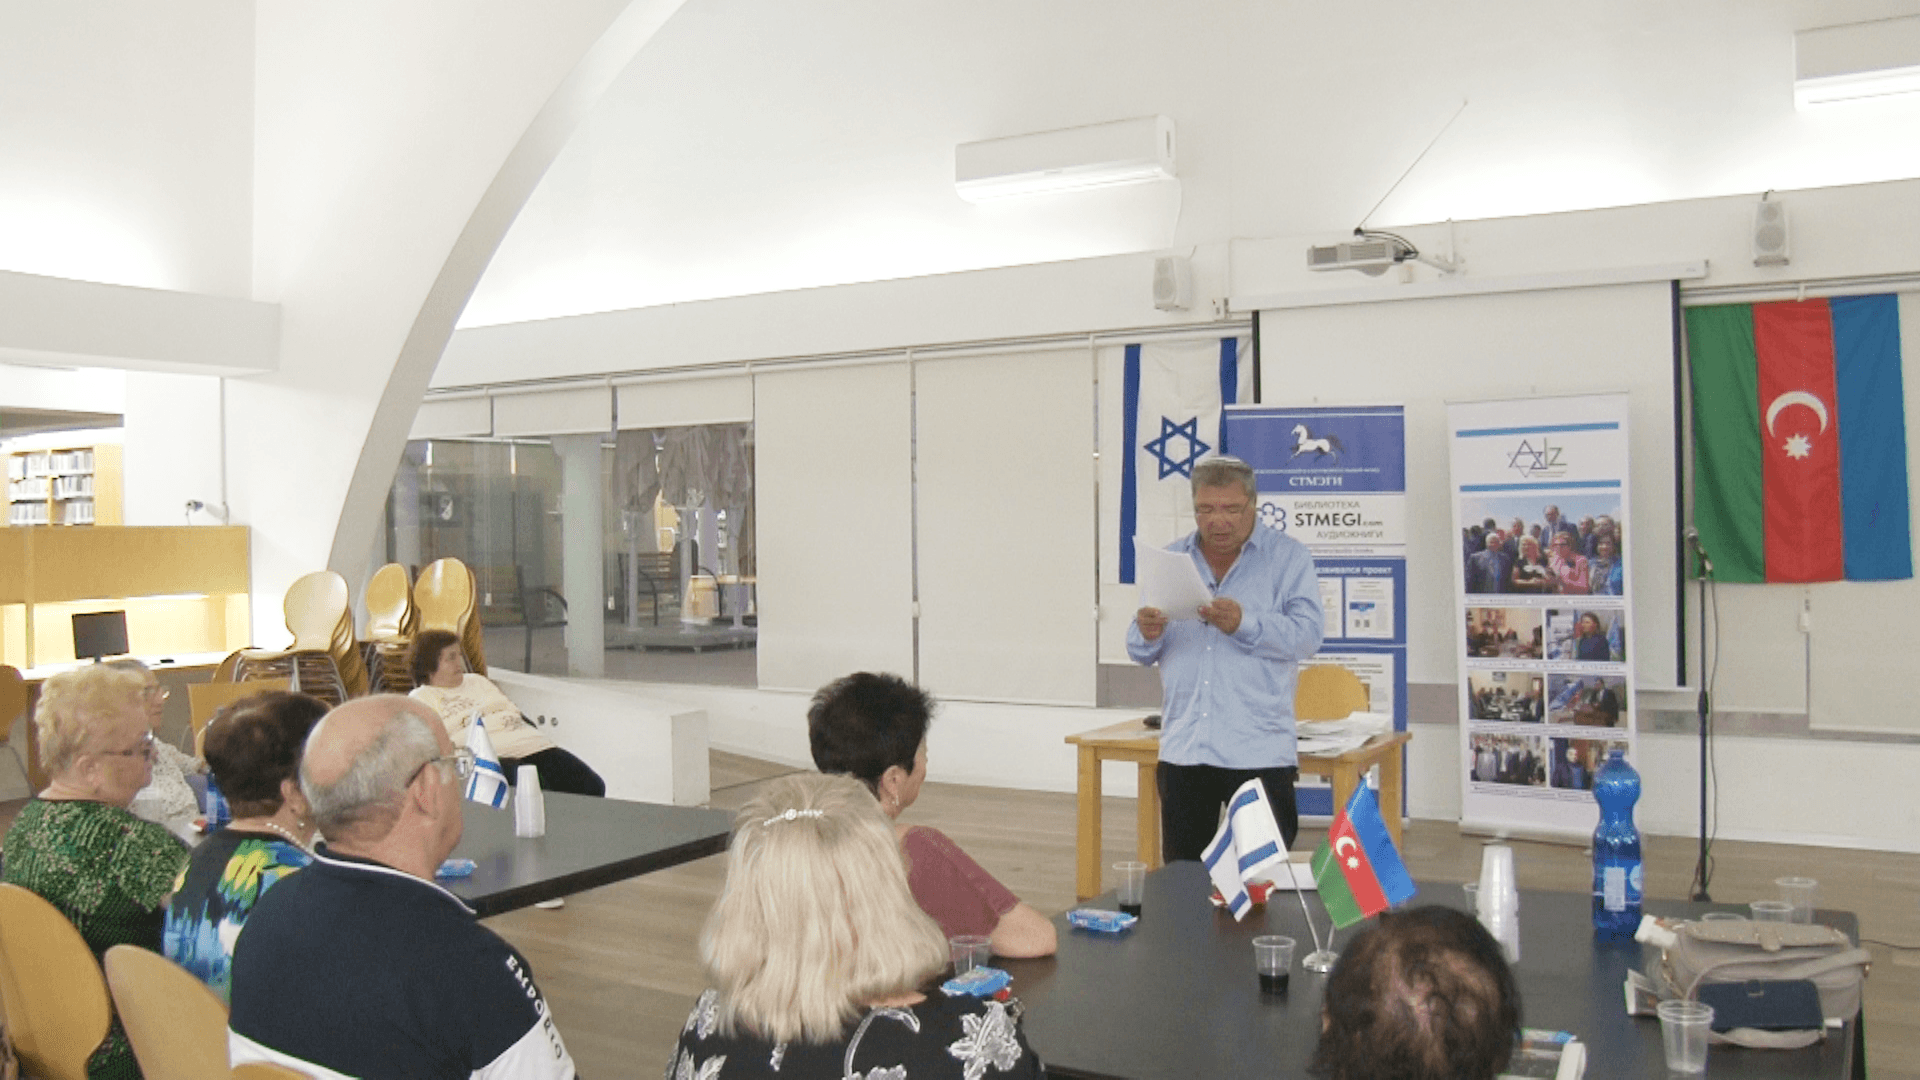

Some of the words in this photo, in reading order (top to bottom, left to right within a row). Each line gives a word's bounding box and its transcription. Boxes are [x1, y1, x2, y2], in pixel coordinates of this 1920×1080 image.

[1289, 476, 1343, 487] СТМЭГИ
[1316, 531, 1383, 540] АУДИОКНИГИ
[1363, 566, 1393, 576] проект
[505, 954, 563, 1060] EMPORIO
